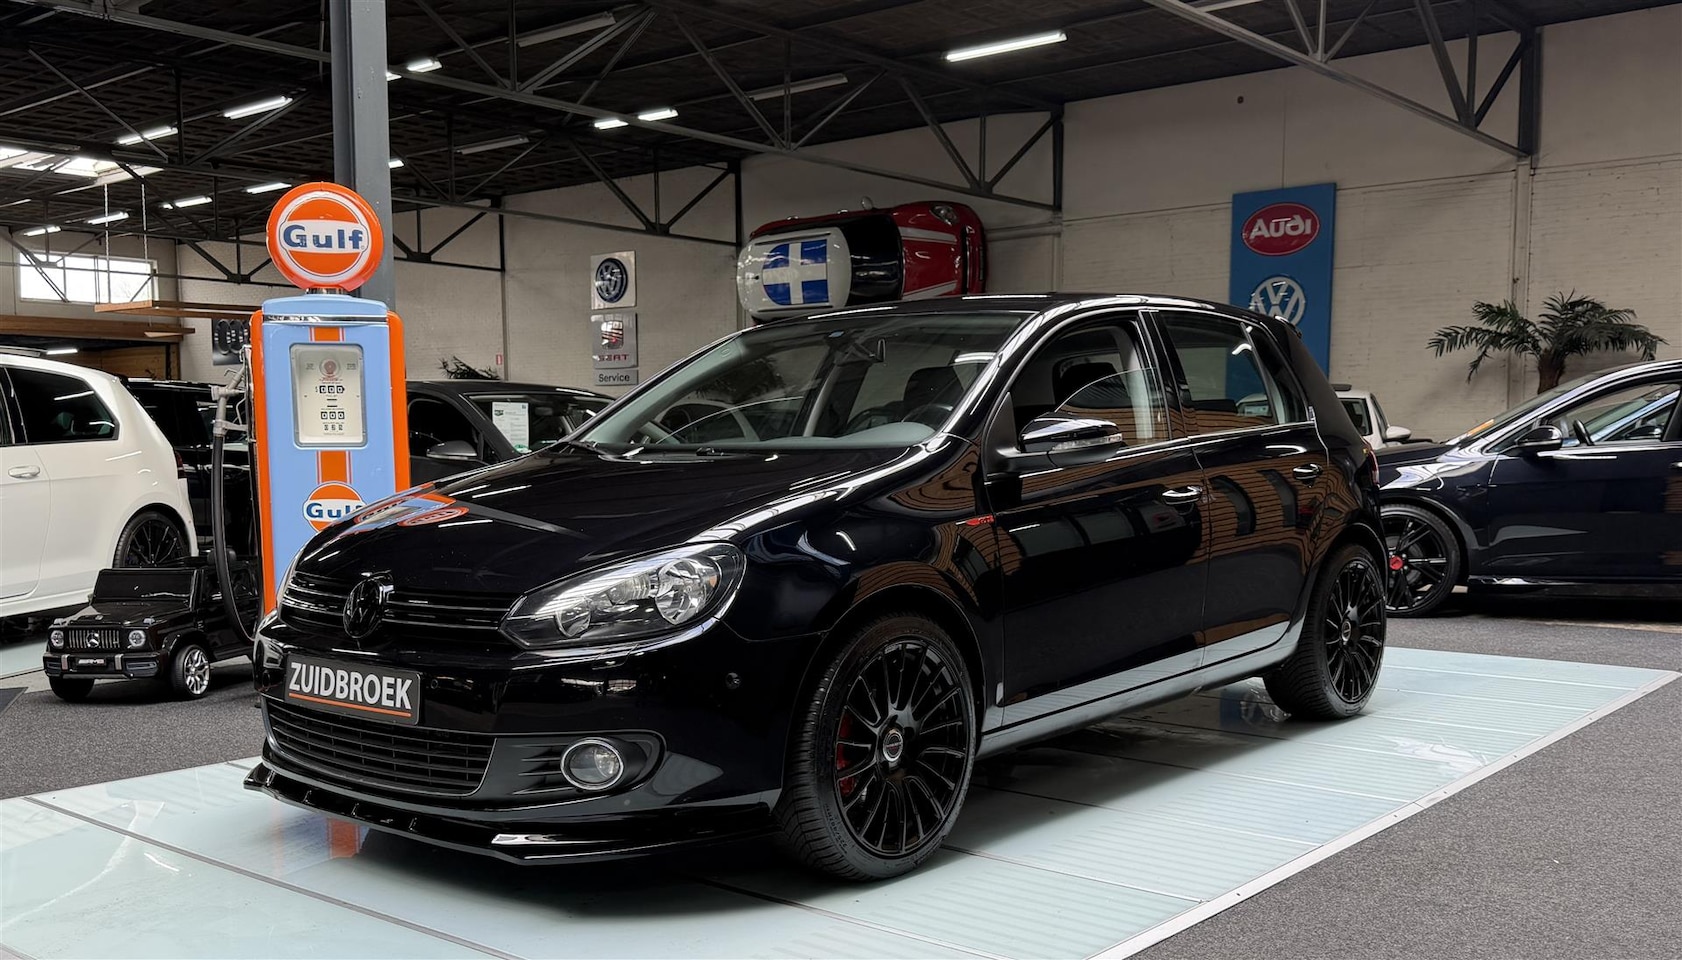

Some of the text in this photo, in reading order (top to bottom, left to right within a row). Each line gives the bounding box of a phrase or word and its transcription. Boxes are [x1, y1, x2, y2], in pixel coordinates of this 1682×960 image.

[283, 224, 364, 250] Gulf
[598, 373, 630, 383] Service
[306, 502, 363, 518] Gul
[289, 662, 412, 709] ZUIDBROEK
